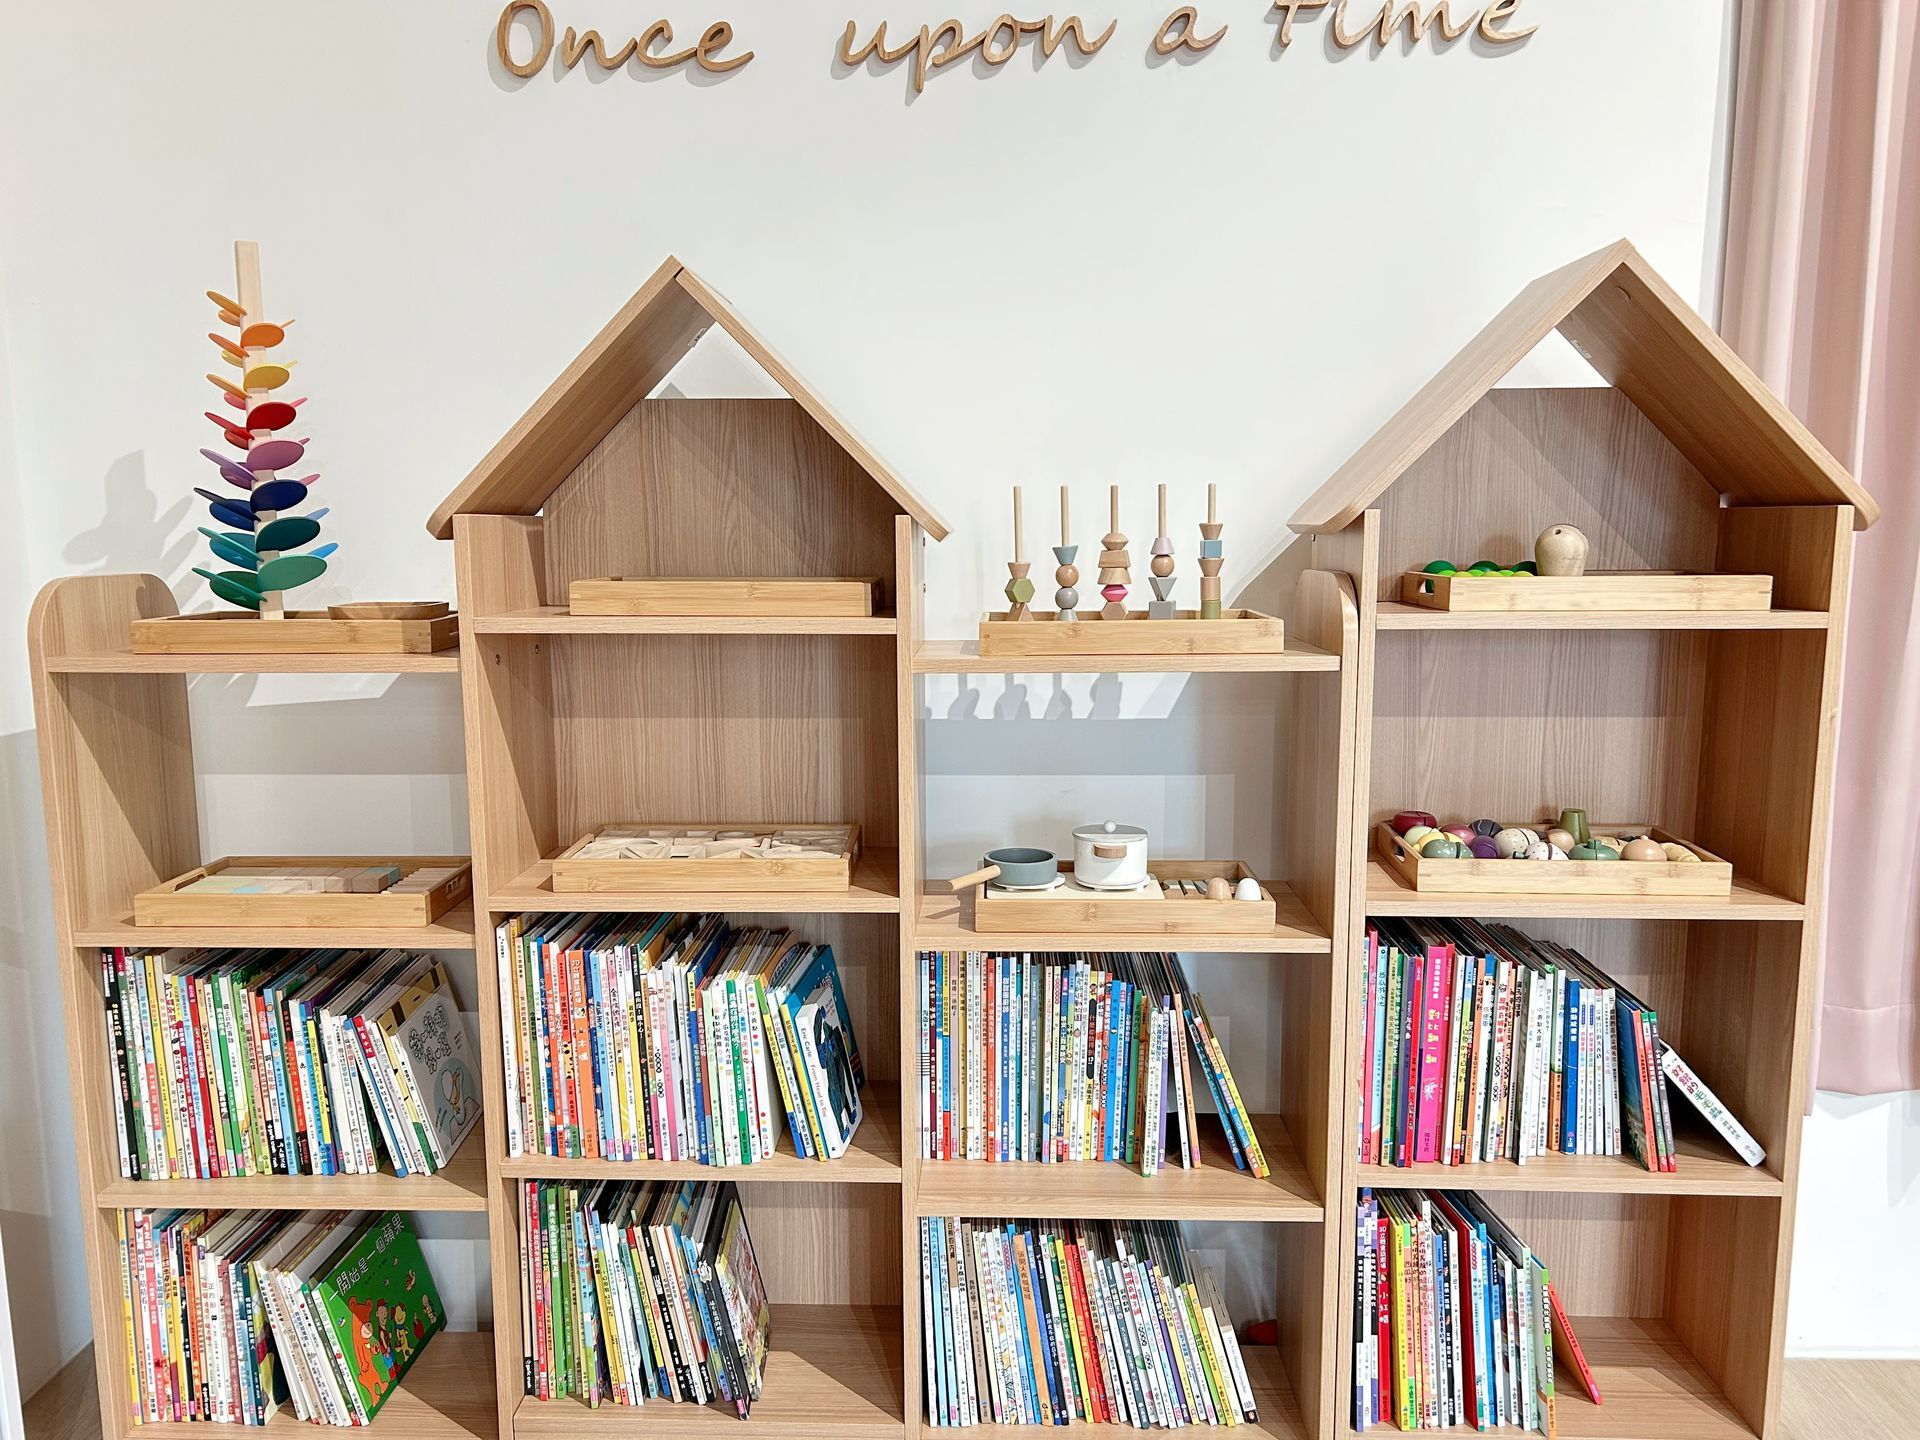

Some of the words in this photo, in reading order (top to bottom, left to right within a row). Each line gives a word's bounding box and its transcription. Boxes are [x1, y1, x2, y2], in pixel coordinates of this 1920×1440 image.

[498, 0, 754, 78] Once
[838, 10, 1118, 93] upon
[1154, 4, 1228, 54] a
[1272, 0, 1538, 47] time
[800, 1027, 809, 1039] Eric
[804, 1040, 813, 1057] Carle
[809, 1064, 818, 1080] From
[813, 1082, 823, 1097] Head
[820, 1106, 829, 1117] Toe
[329, 1213, 404, 1301] 一開始是一個蘋果
[1217, 1355, 1228, 1374] Dear
